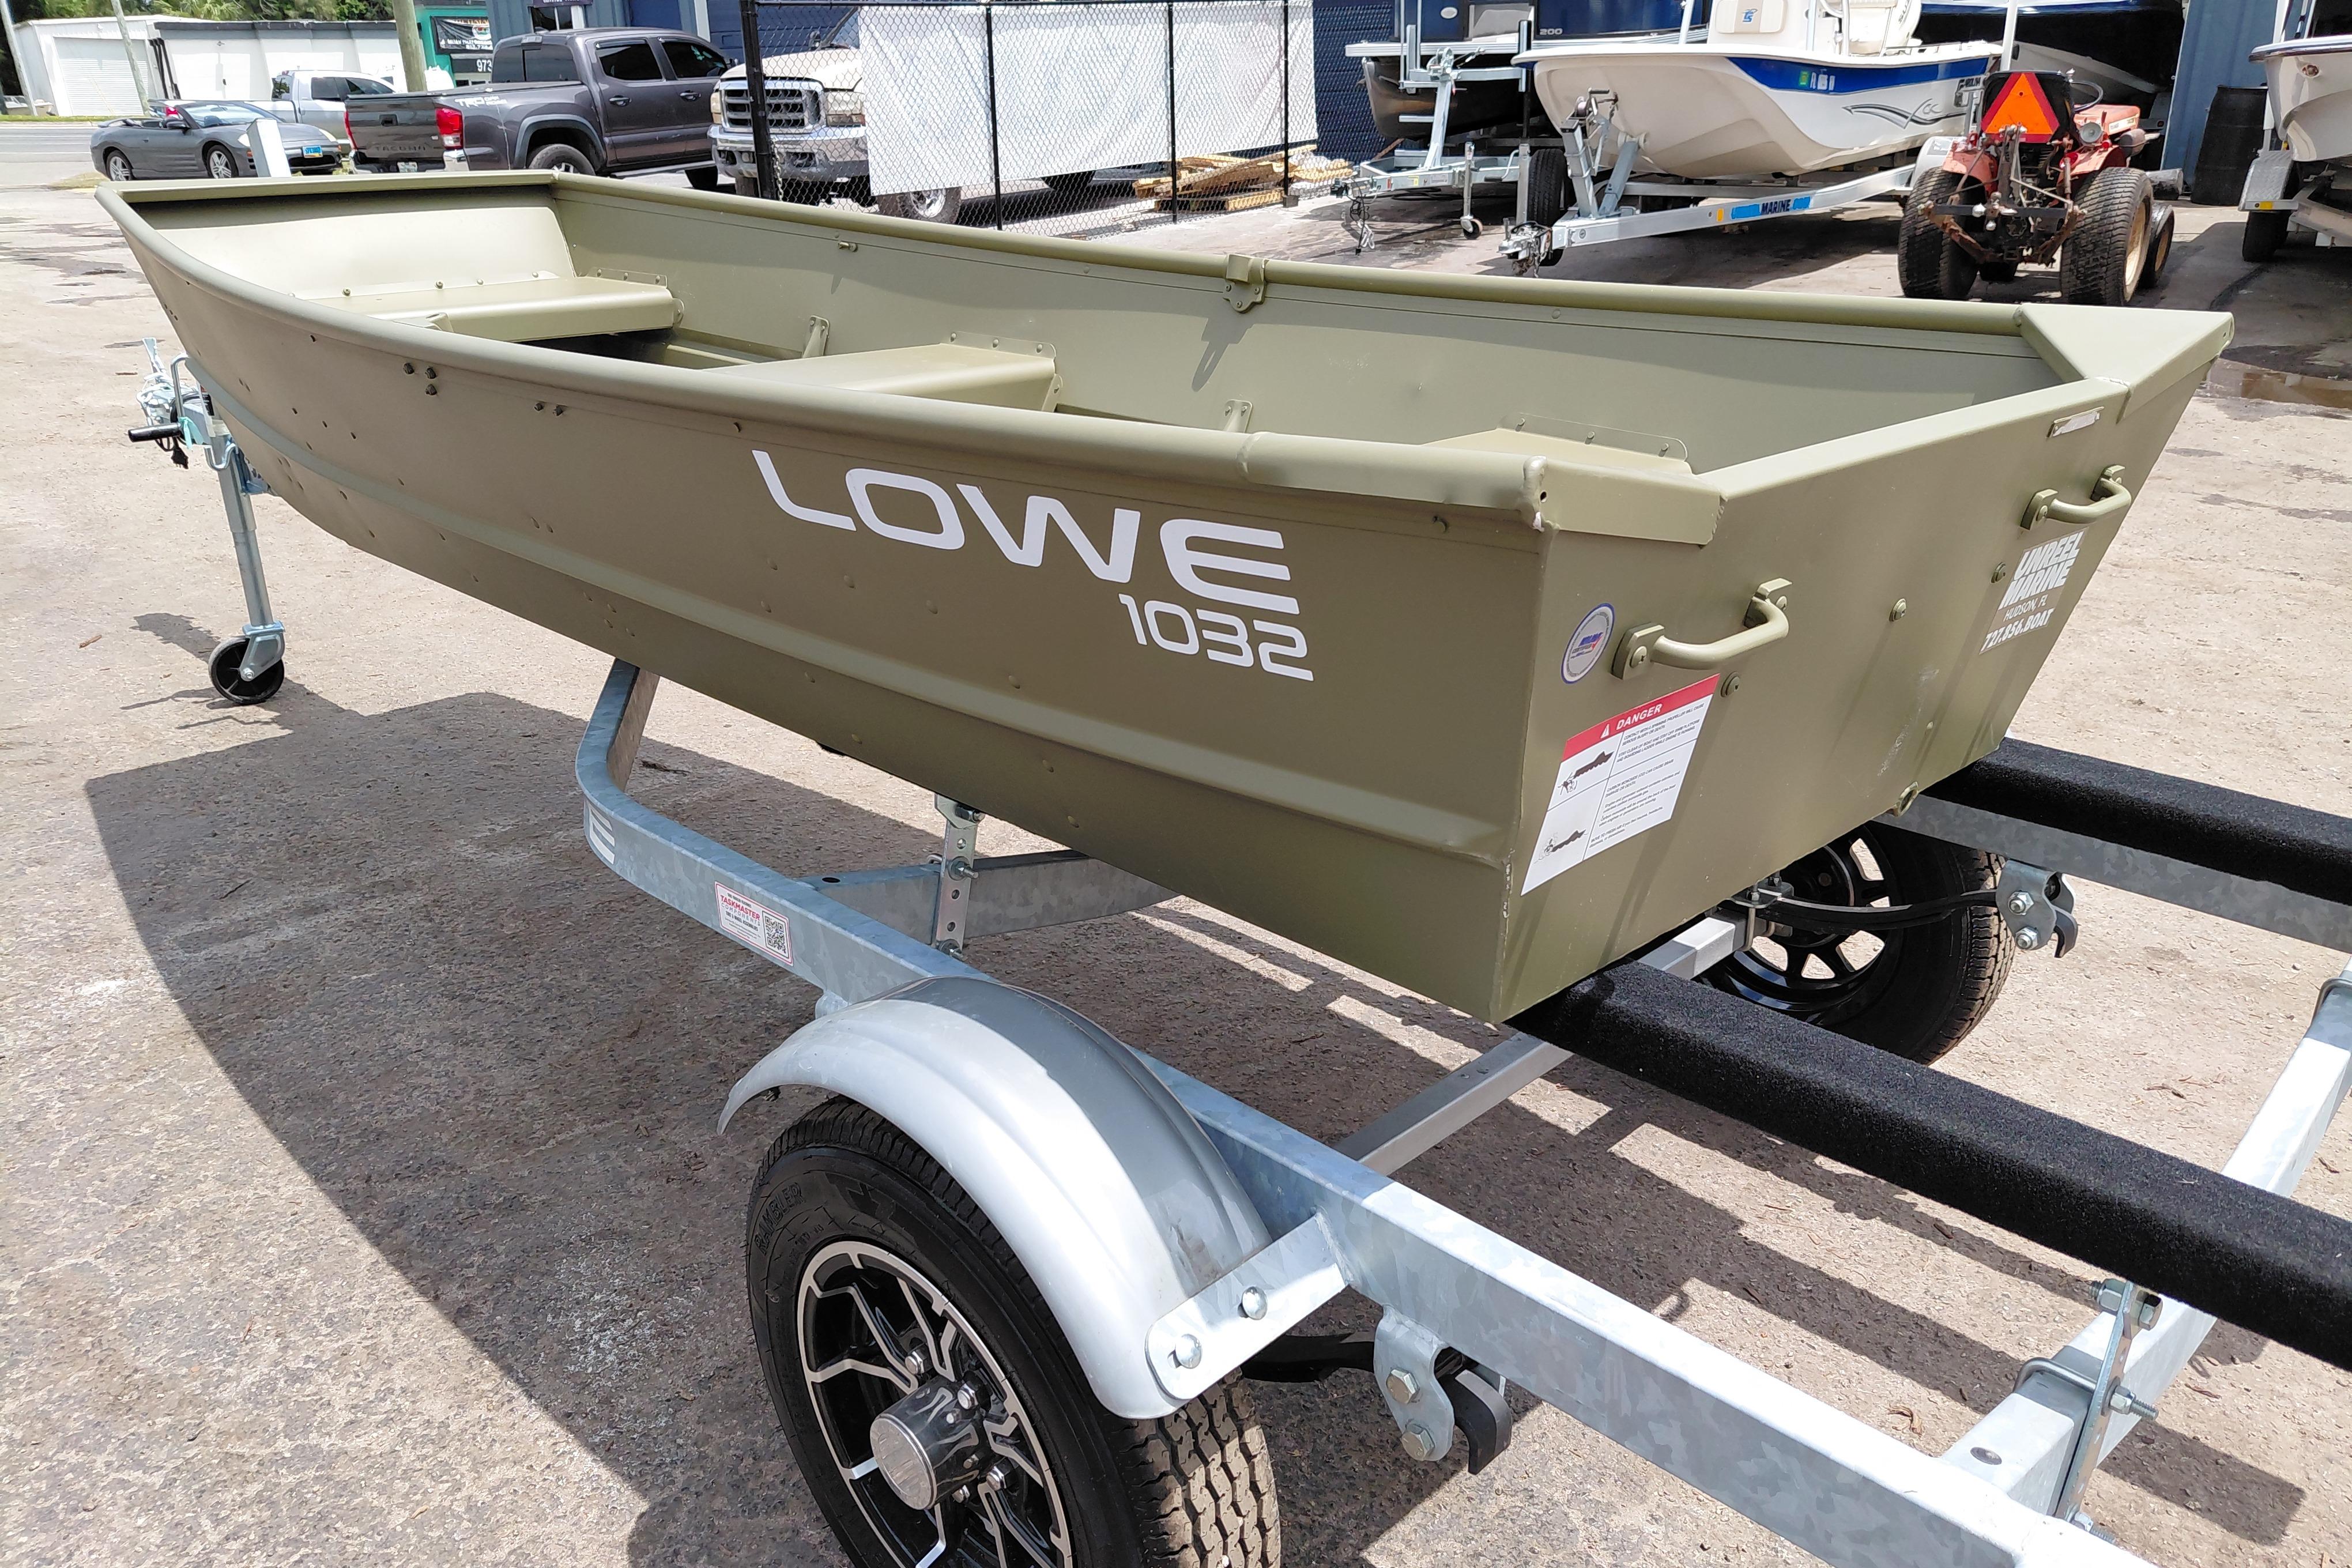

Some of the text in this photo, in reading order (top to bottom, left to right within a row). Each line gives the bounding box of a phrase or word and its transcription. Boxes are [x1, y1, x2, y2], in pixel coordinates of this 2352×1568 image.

[1761, 199, 1792, 215] MARINE
[751, 450, 1301, 615] LOWE
[2014, 531, 2084, 581] UNREEL
[1998, 558, 2075, 610] MARINE
[1980, 608, 2055, 652] 727.856.BOAT
[2003, 594, 2048, 622] HUDSON, FL
[1118, 593, 1314, 683] 1032
[1616, 703, 1663, 730] DANGER
[721, 895, 760, 921] TASKMASTER
[721, 903, 760, 926] COMPONENTS
[753, 1182, 806, 1256] RAMBLER
